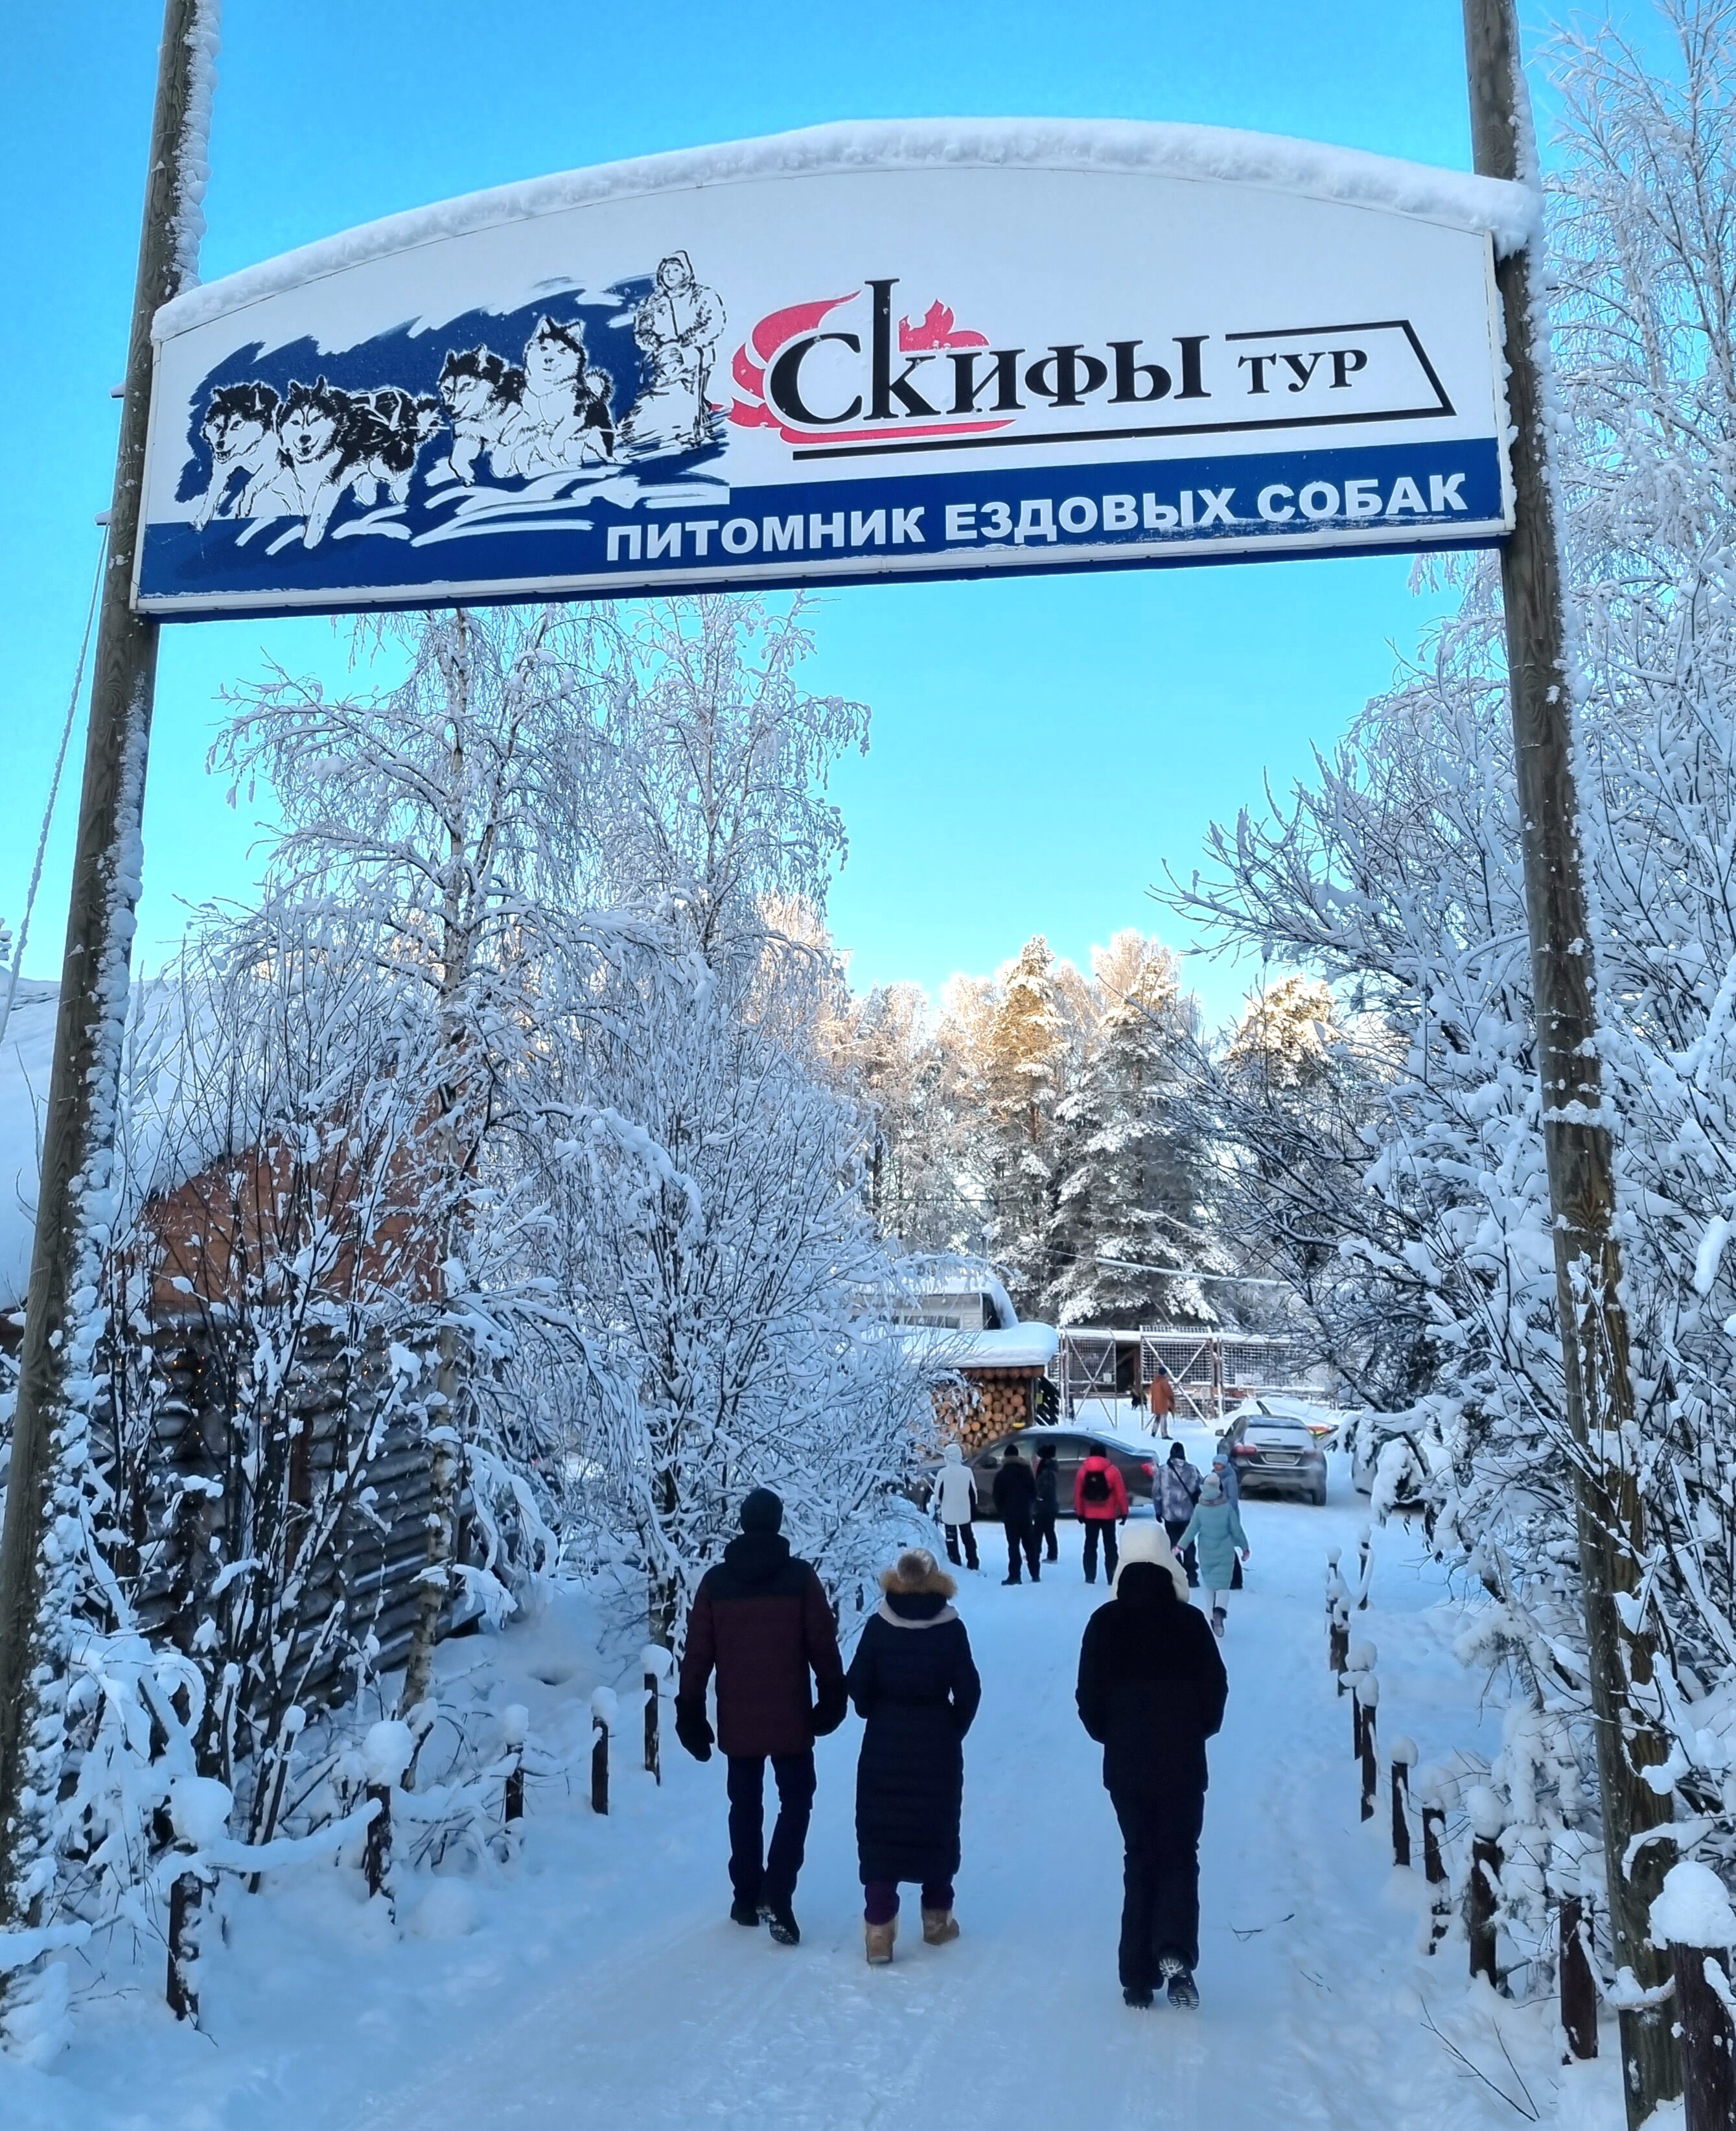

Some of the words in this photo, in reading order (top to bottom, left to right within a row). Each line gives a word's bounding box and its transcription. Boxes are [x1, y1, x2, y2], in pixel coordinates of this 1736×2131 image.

[607, 507, 925, 561] ПИТОМНИК
[945, 488, 1236, 543] ЕЗДОВЫХ
[1257, 472, 1468, 522] СОБАК
